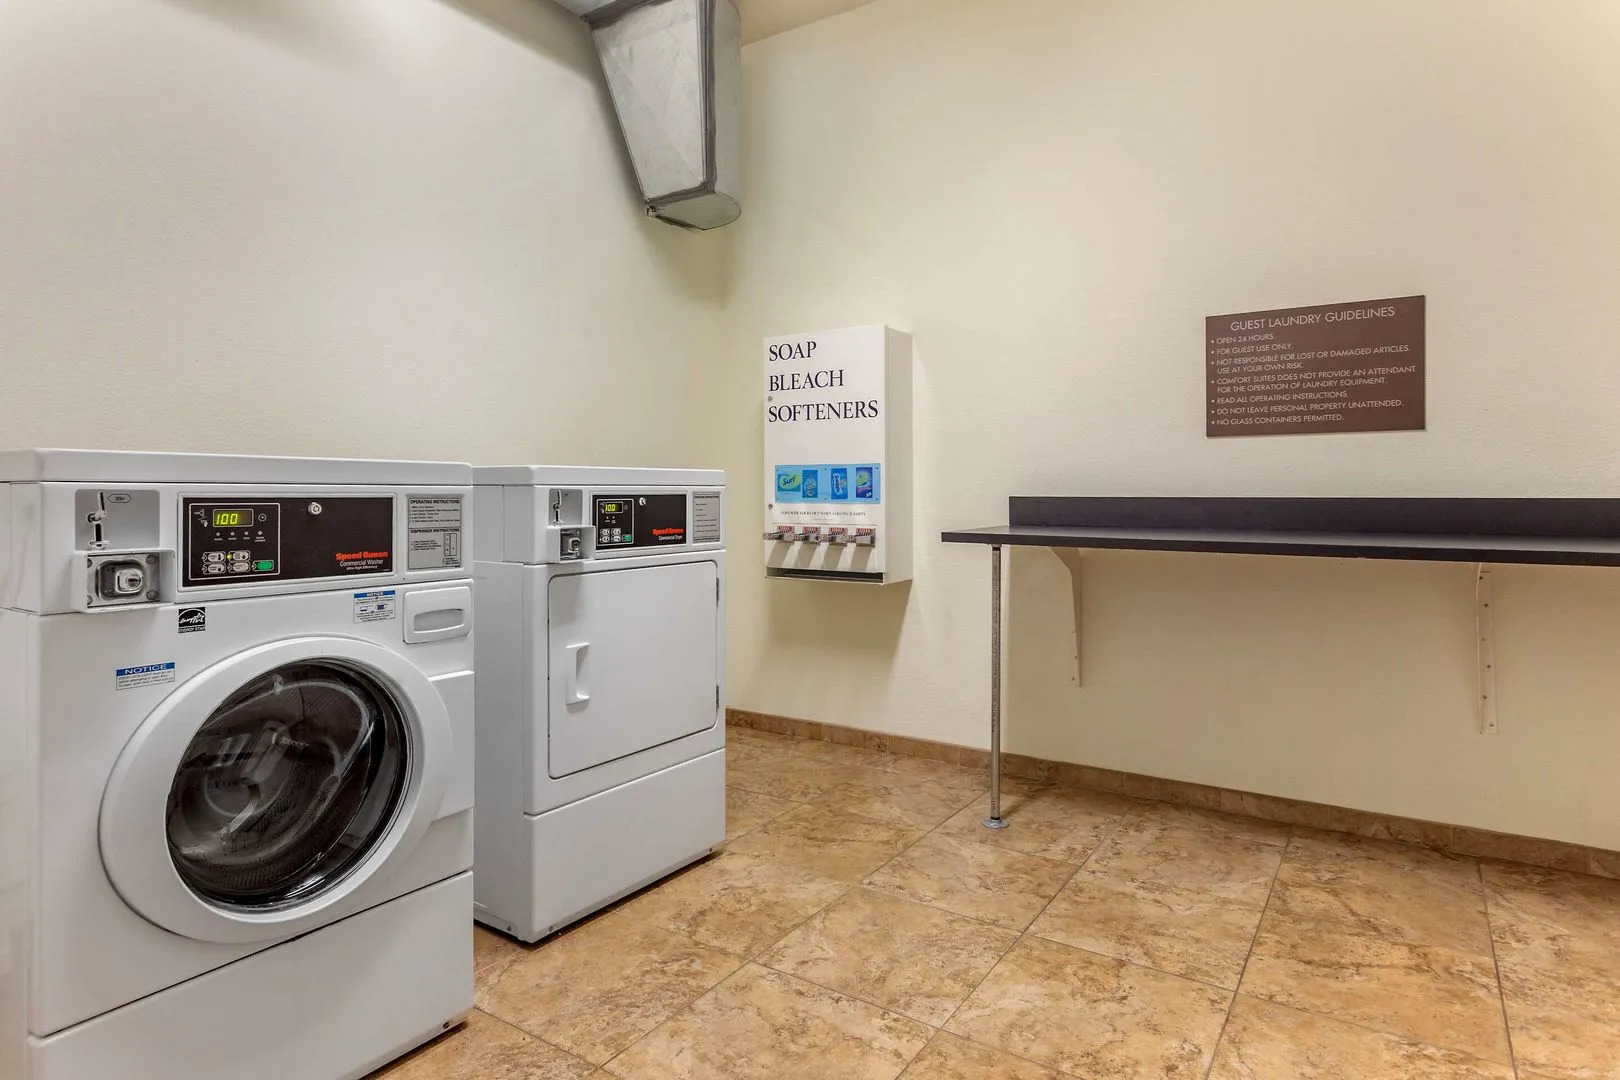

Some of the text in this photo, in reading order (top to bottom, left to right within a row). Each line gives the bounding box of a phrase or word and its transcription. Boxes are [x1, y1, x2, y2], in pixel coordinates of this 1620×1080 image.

[1230, 306, 1395, 331] GUEST LAUNDRY GUIDELINES
[1216, 333, 1275, 344] OPEN 24 HOURS.
[768, 340, 817, 362] SOAP
[1231, 346, 1255, 354] GUEST
[1256, 344, 1270, 352] USE
[1271, 343, 1293, 351] ONLY.
[1234, 354, 1279, 365] RESPONSIBLE
[1280, 353, 1295, 361] FOR
[1297, 352, 1315, 360] LOST
[1330, 347, 1372, 357] DAMAGED
[1373, 344, 1410, 354] ARTICLES.
[1242, 364, 1263, 373] YOUR
[1264, 363, 1285, 371] OWN
[769, 369, 844, 392] BLEACH
[1217, 376, 1252, 385] COMFORT
[1253, 374, 1276, 382] SUITES
[1277, 373, 1298, 381] DOES
[1318, 370, 1351, 379] PROVIDE
[1367, 365, 1416, 375] ATTENDANT
[1247, 382, 1289, 392] OPERATION
[1290, 381, 1301, 389] OF
[1303, 379, 1338, 388] LAUNDRY
[1339, 377, 1388, 386] EQUIPMENT.
[1249, 393, 1291, 402] OPERATING
[1292, 390, 1349, 400] INSTRUCTIONS.
[768, 399, 879, 423] SOFTENERS
[1247, 405, 1269, 413] LEAVE
[1270, 403, 1308, 412] PERSONAL
[1310, 402, 1347, 410] PROPERTY
[1348, 399, 1404, 409] UNATTENDED.
[1230, 417, 1253, 425] GLASS
[1254, 415, 1302, 424] CONTAINERS
[1303, 413, 1344, 422] PERMITTED.
[782, 475, 796, 486] Surf
[215, 513, 238, 525] 100
[335, 550, 388, 561] Speed Queen
[124, 664, 167, 674] NOTICE
